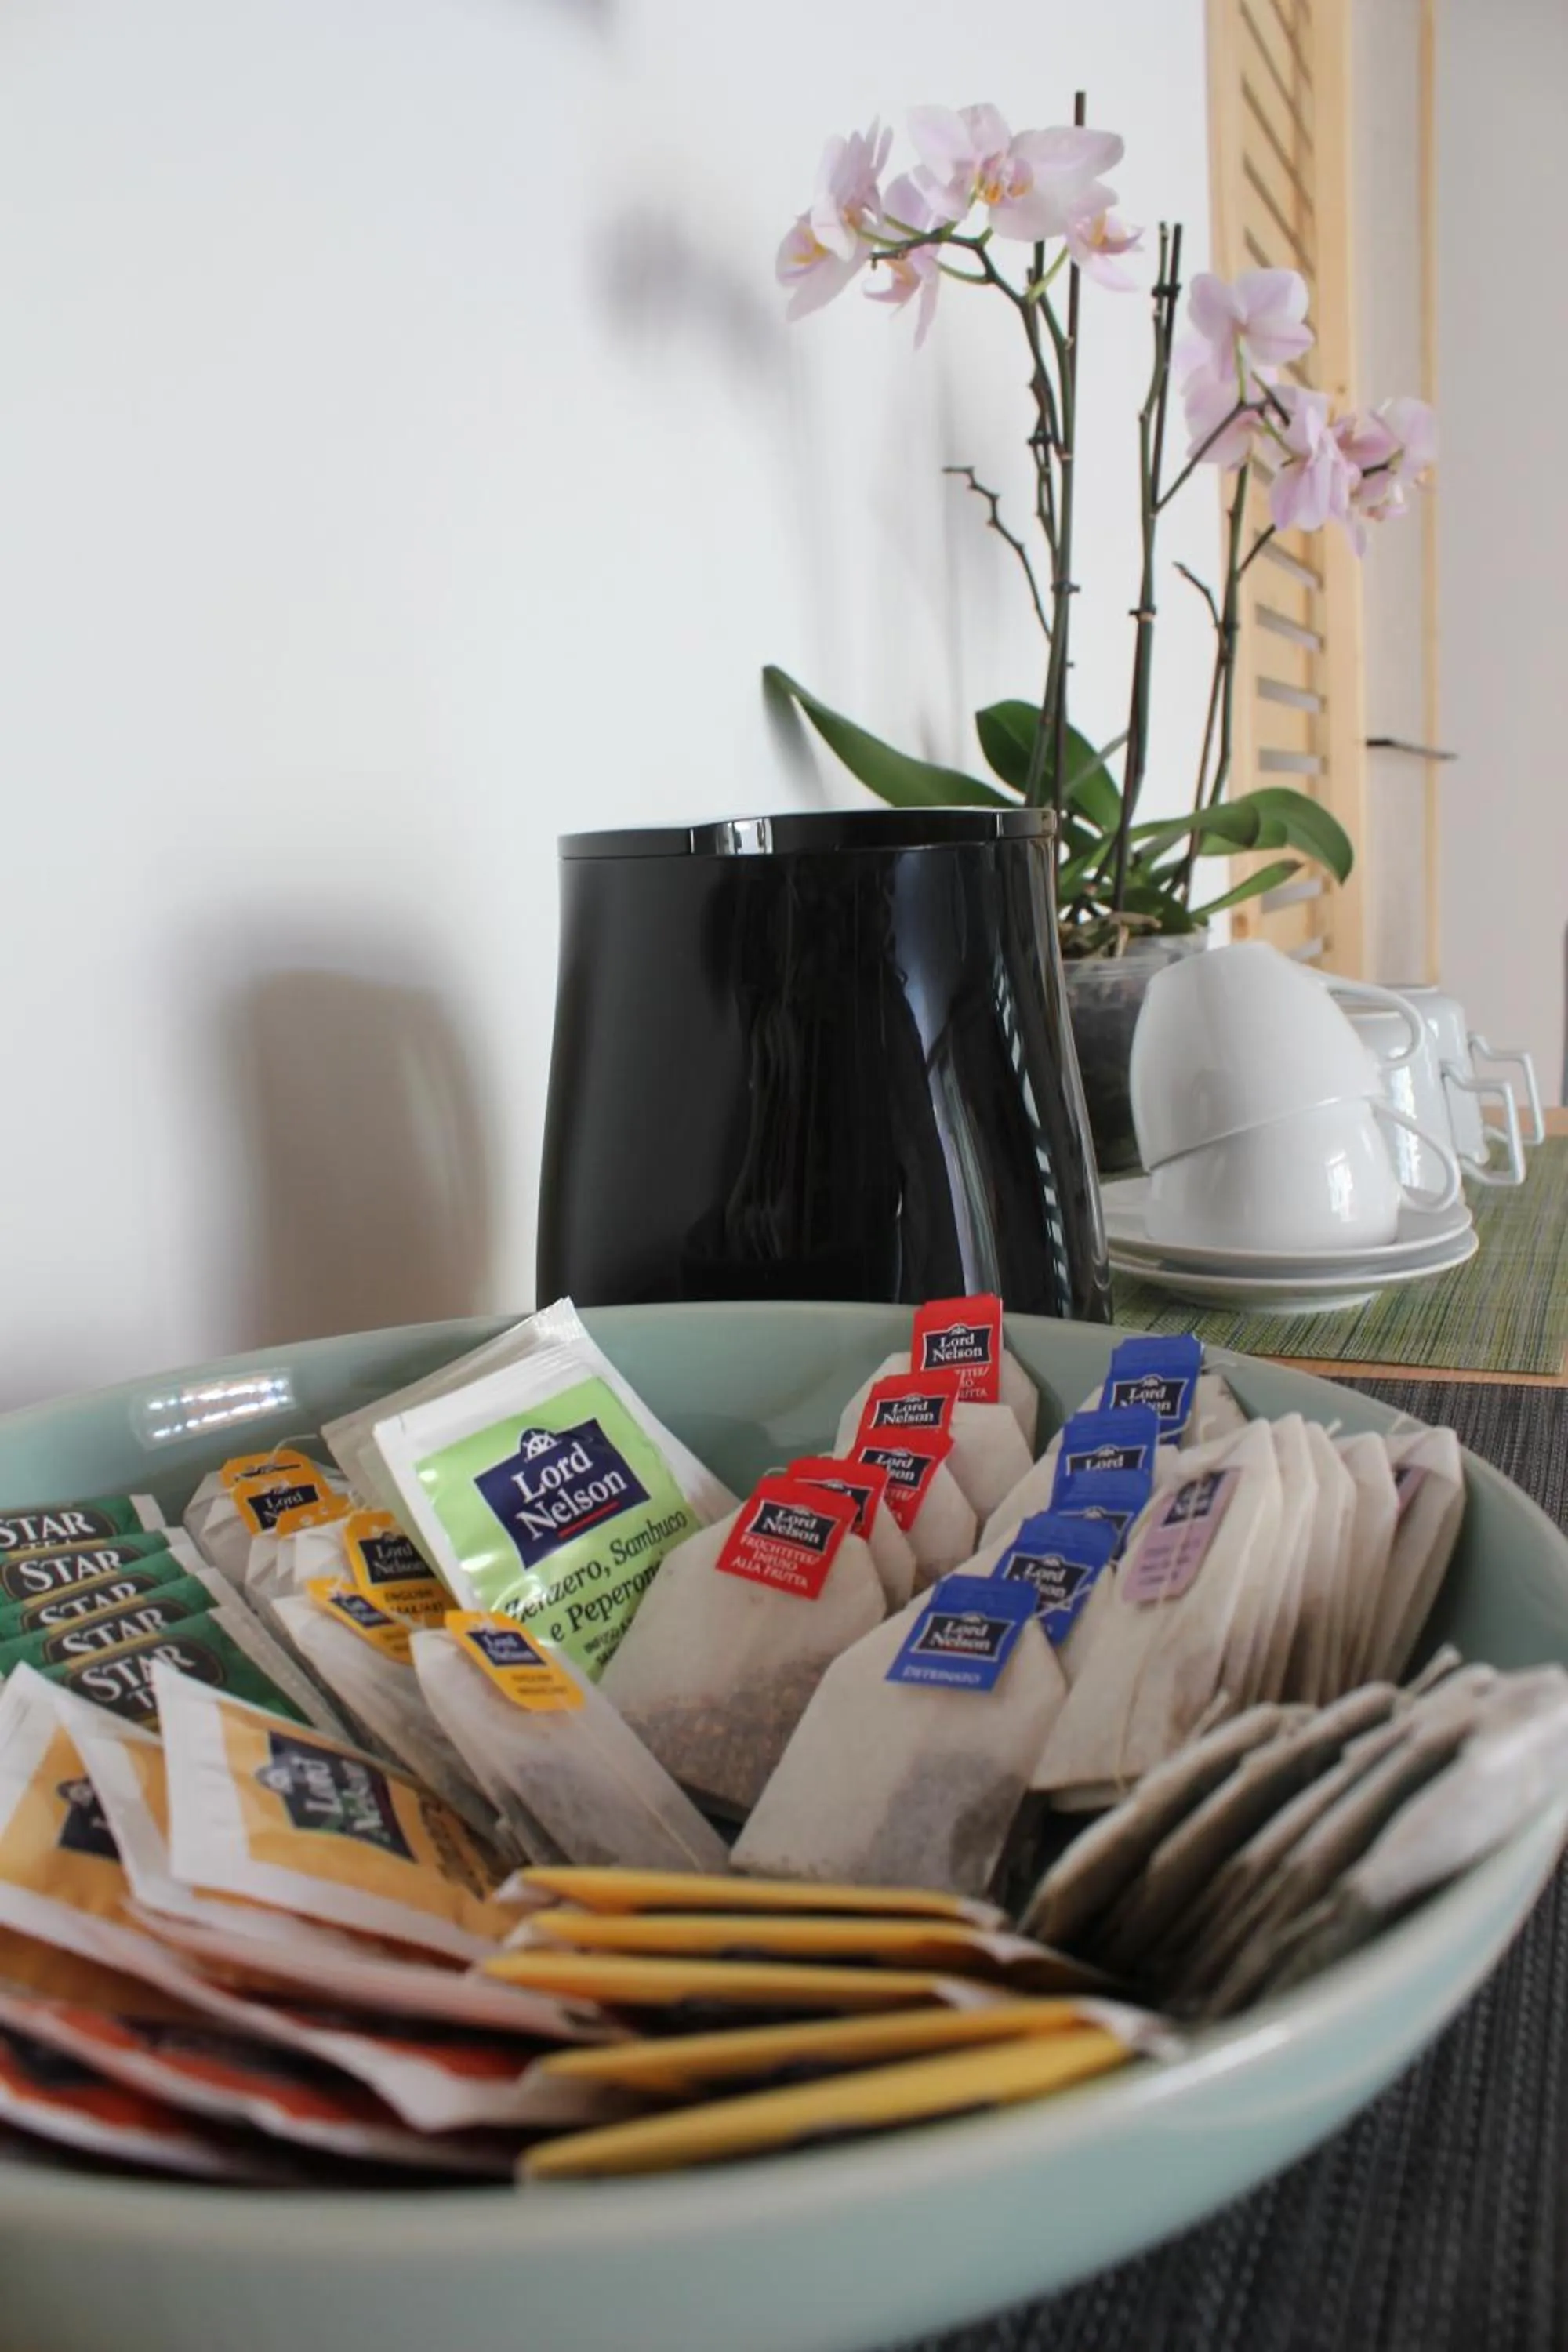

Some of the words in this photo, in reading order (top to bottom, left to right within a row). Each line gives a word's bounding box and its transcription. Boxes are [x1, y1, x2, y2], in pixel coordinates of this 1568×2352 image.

[941, 1333, 975, 1348] Lord
[932, 1345, 982, 1362] Nelson
[1129, 1385, 1167, 1399] Lord
[892, 1400, 928, 1413] Lord
[883, 1411, 935, 1425] Nelson
[875, 1452, 914, 1468] Lord
[1085, 1455, 1124, 1471] Lord
[512, 1441, 593, 1503] Lord
[516, 1469, 628, 1541] Nelson
[776, 1508, 818, 1530] Lord
[609, 1510, 688, 1565] Sambuco
[762, 1517, 820, 1544] Nelson
[19, 1550, 122, 1592] STAR
[1023, 1563, 1067, 1583] Lord
[62, 1608, 169, 1653] STAR
[550, 1622, 564, 1642] e
[943, 1620, 989, 1636] Lord
